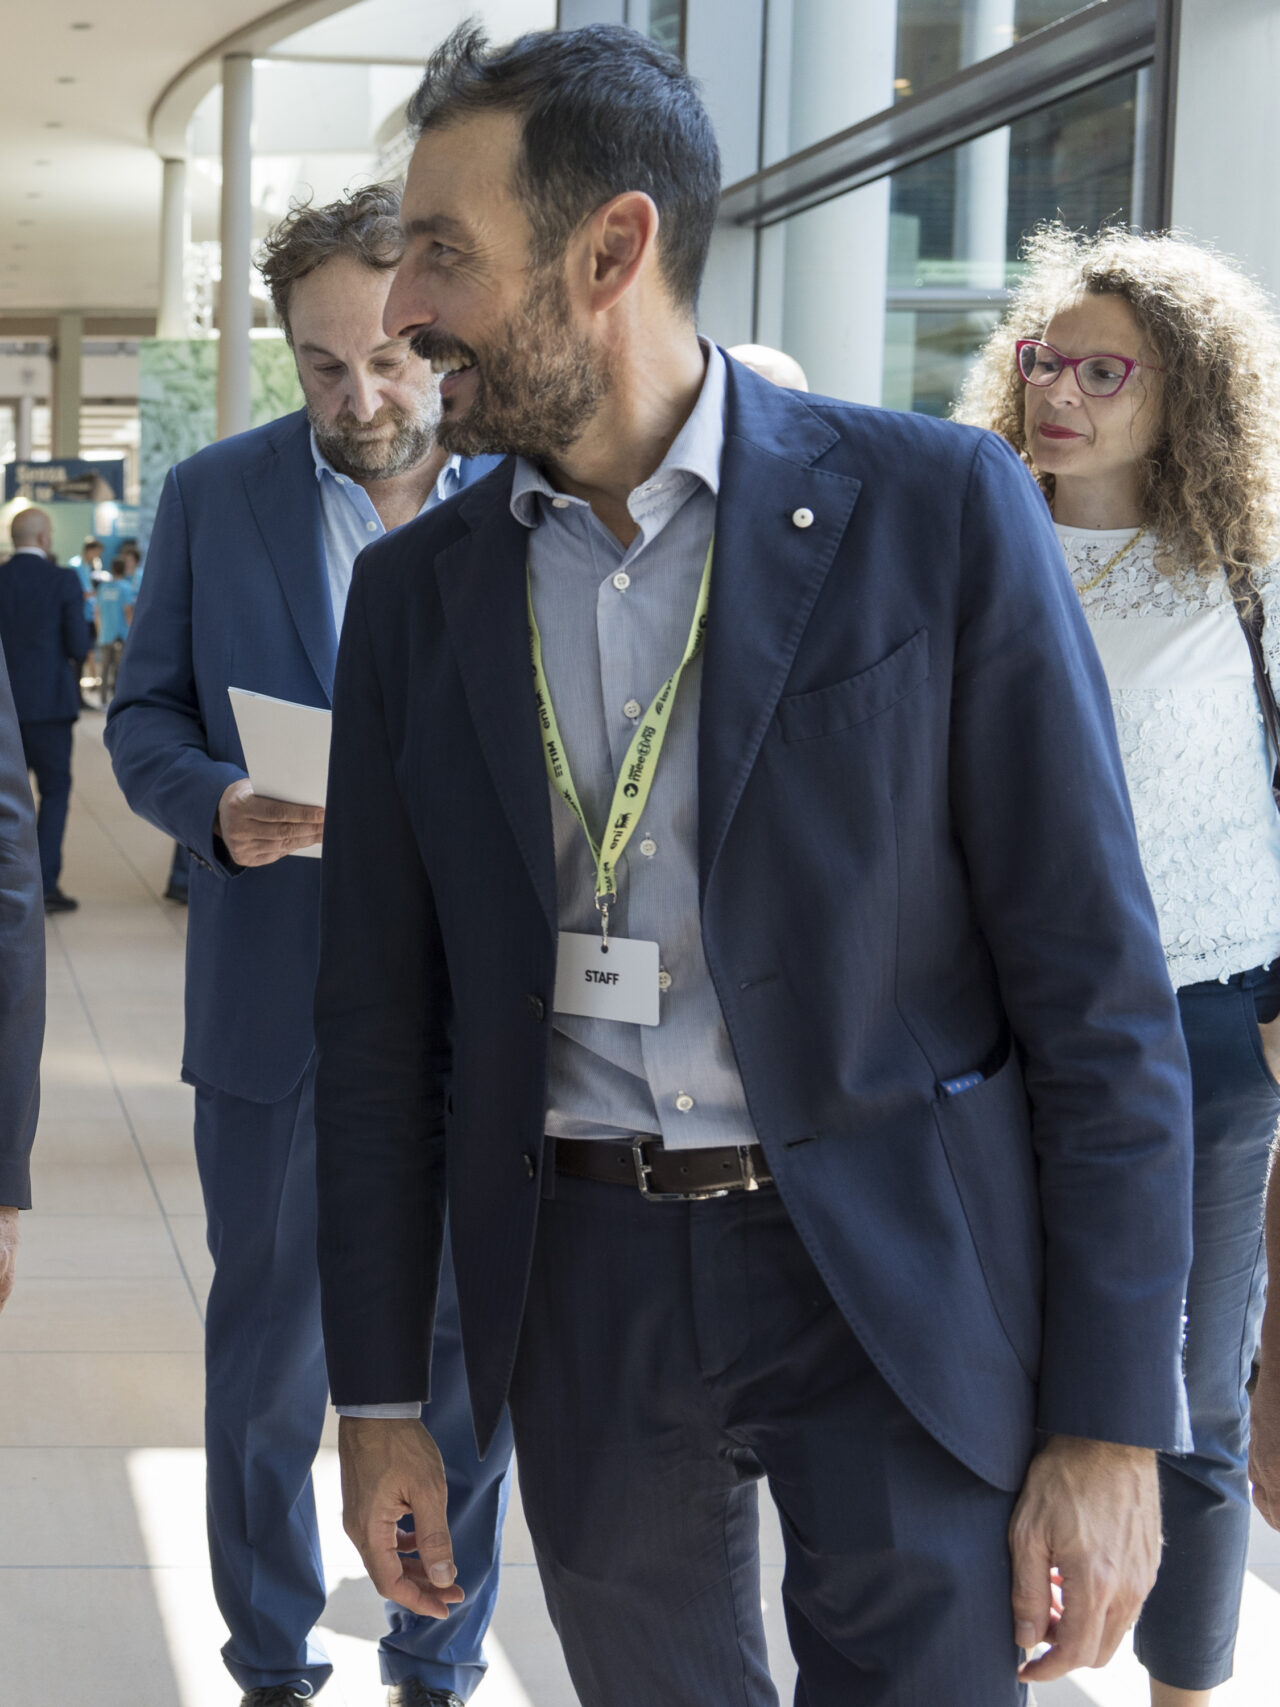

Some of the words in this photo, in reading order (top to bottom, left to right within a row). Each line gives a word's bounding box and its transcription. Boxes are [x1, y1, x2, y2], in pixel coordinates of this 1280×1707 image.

[546, 741, 560, 764] TIM
[632, 727, 656, 782] meeting
[610, 829, 625, 850] eni
[585, 969, 620, 985] STAFF
